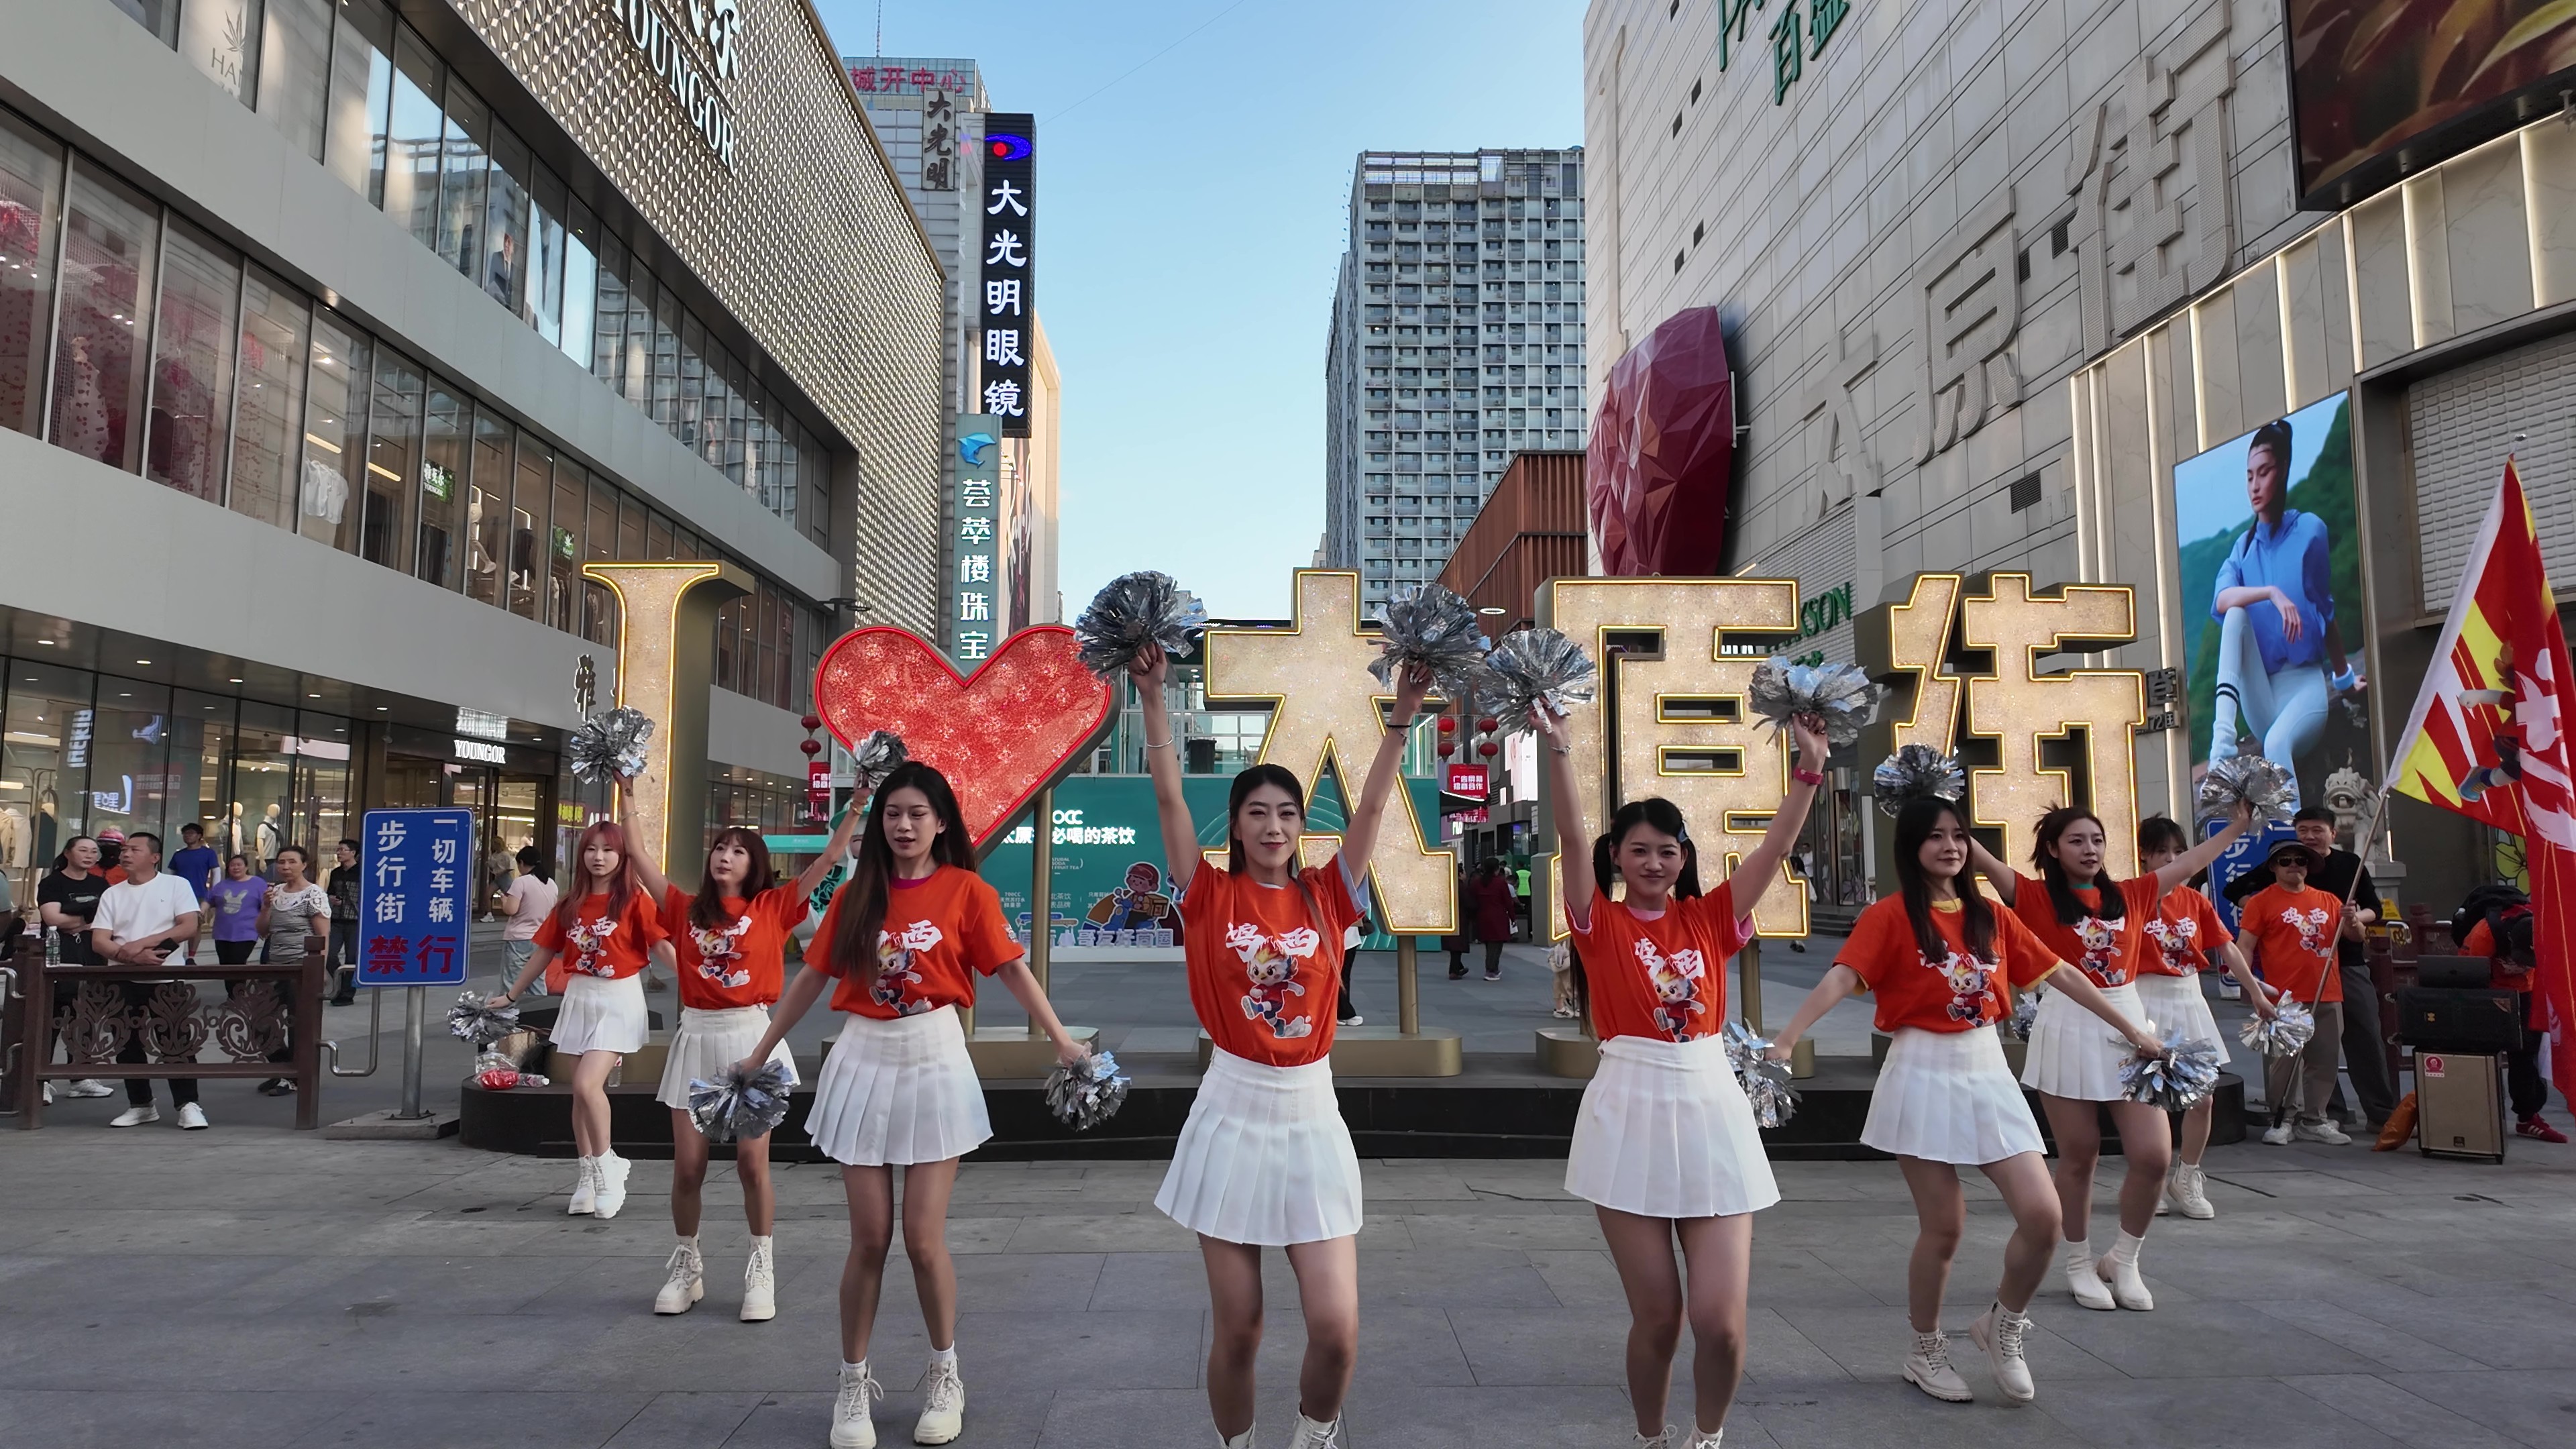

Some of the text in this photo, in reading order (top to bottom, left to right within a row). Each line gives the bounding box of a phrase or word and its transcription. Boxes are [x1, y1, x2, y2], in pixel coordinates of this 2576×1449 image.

[211, 47, 242, 88] HA
[851, 66, 966, 93] 城开中心
[924, 90, 951, 190] 大光明
[983, 179, 1028, 417] 大光明眼镜
[959, 478, 991, 660] 荟萃楼珠宝
[453, 739, 506, 764] YOUNGOR
[1204, 568, 2146, 939] 太原街
[375, 820, 407, 924] 步行街
[429, 819, 458, 923] 一切车辆
[1001, 826, 1136, 845] 太原必喝的茶饮
[367, 934, 457, 975] 禁行
